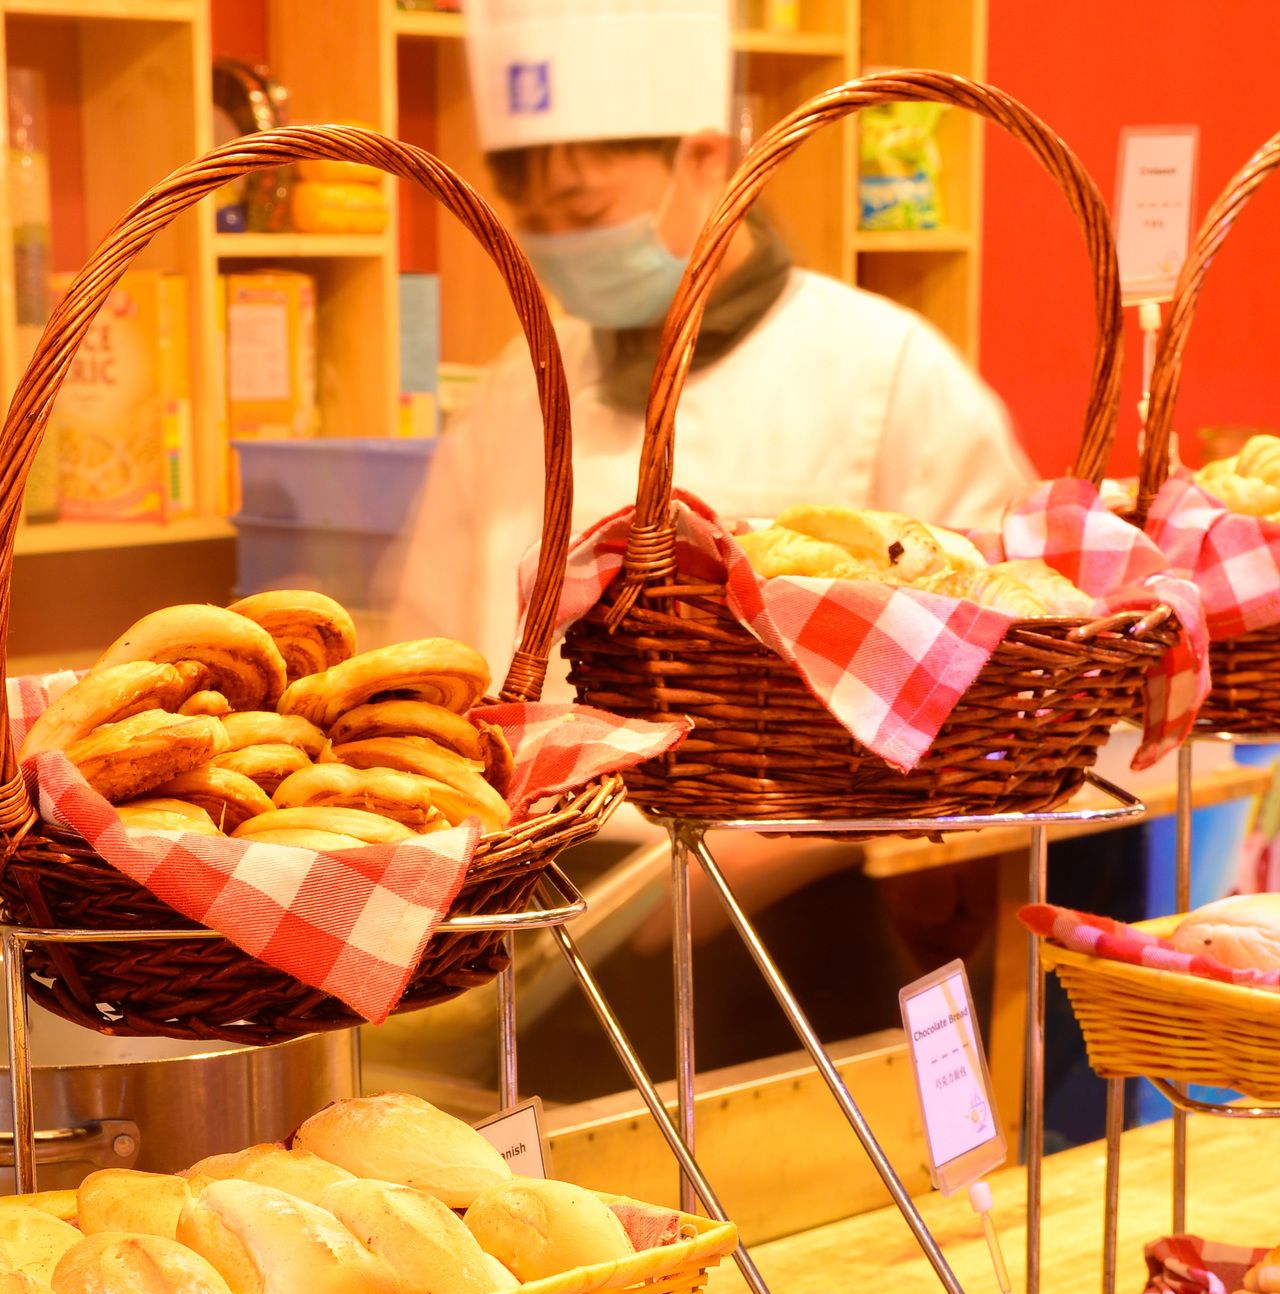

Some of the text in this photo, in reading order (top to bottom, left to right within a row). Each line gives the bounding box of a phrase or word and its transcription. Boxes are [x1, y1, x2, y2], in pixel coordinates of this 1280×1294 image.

[913, 1006, 968, 1042] Chocolate Bread
[500, 1142, 526, 1160] anish
